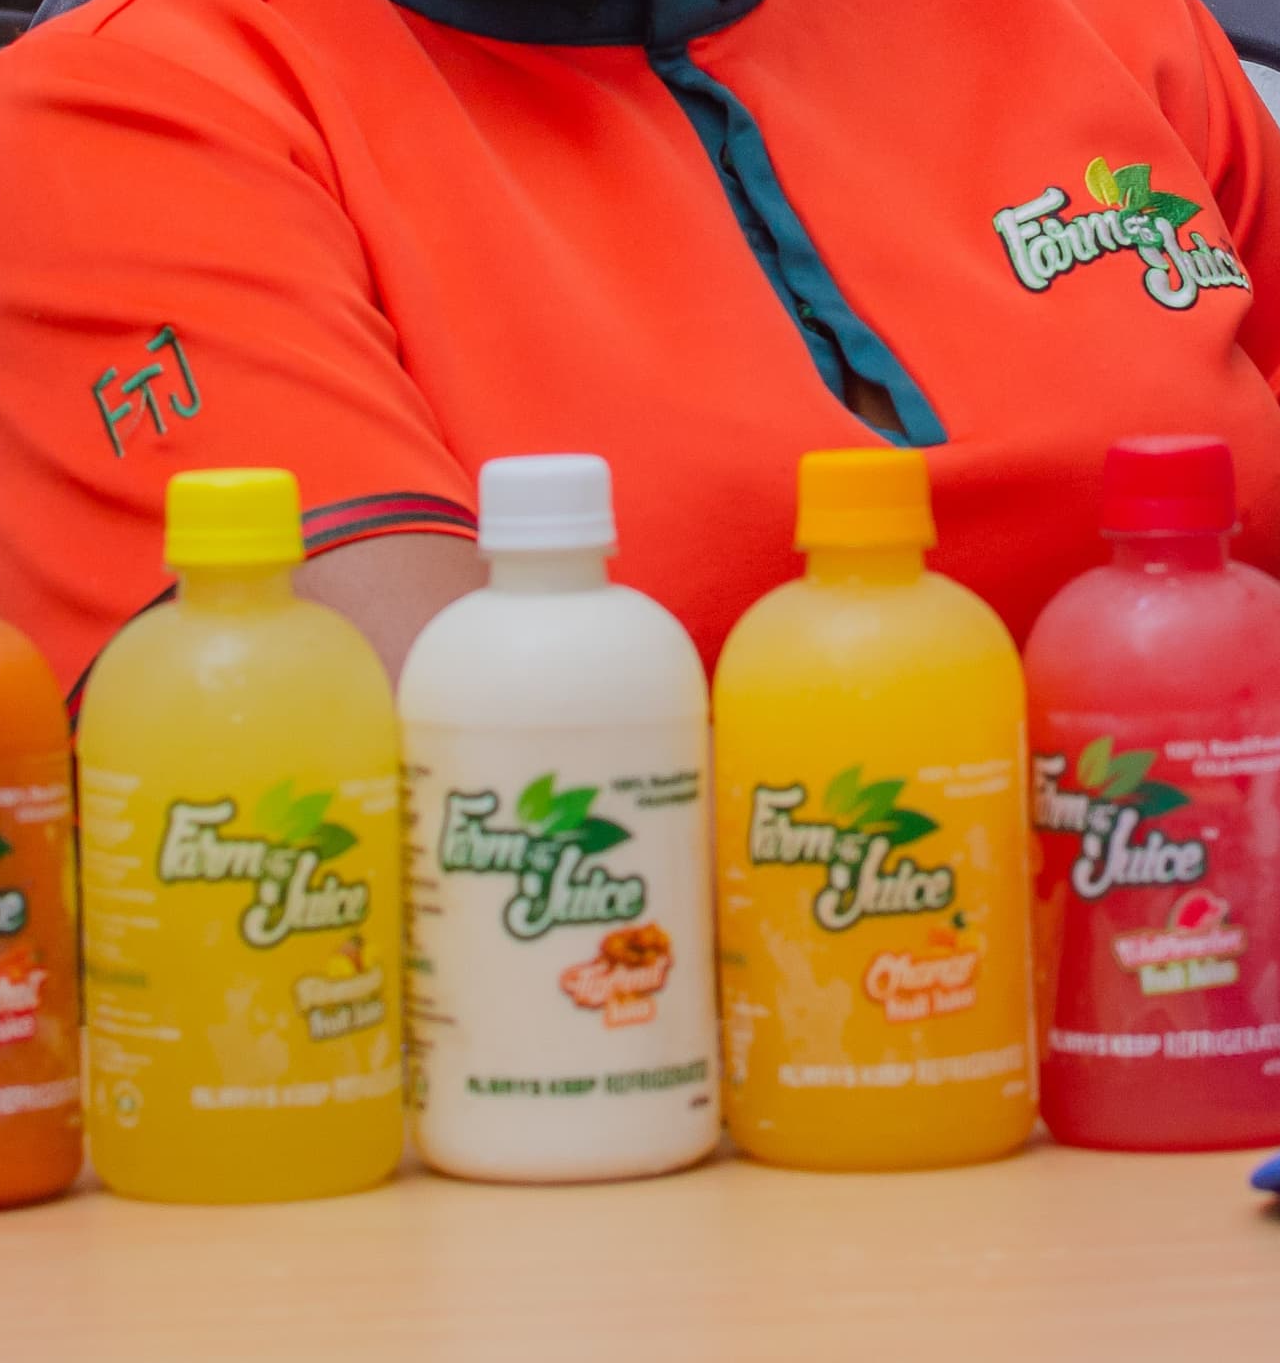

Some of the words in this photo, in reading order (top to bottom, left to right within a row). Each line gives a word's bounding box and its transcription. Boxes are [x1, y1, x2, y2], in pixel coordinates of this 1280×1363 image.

[993, 187, 1131, 292] Farm
[93, 326, 201, 458] FTJ
[159, 800, 264, 883] Farm
[440, 790, 528, 873] Farm
[750, 783, 837, 864] Farm
[1072, 806, 1207, 900] Juice
[241, 851, 370, 949] Juice
[503, 845, 645, 943] Juice
[815, 836, 955, 932] Juice
